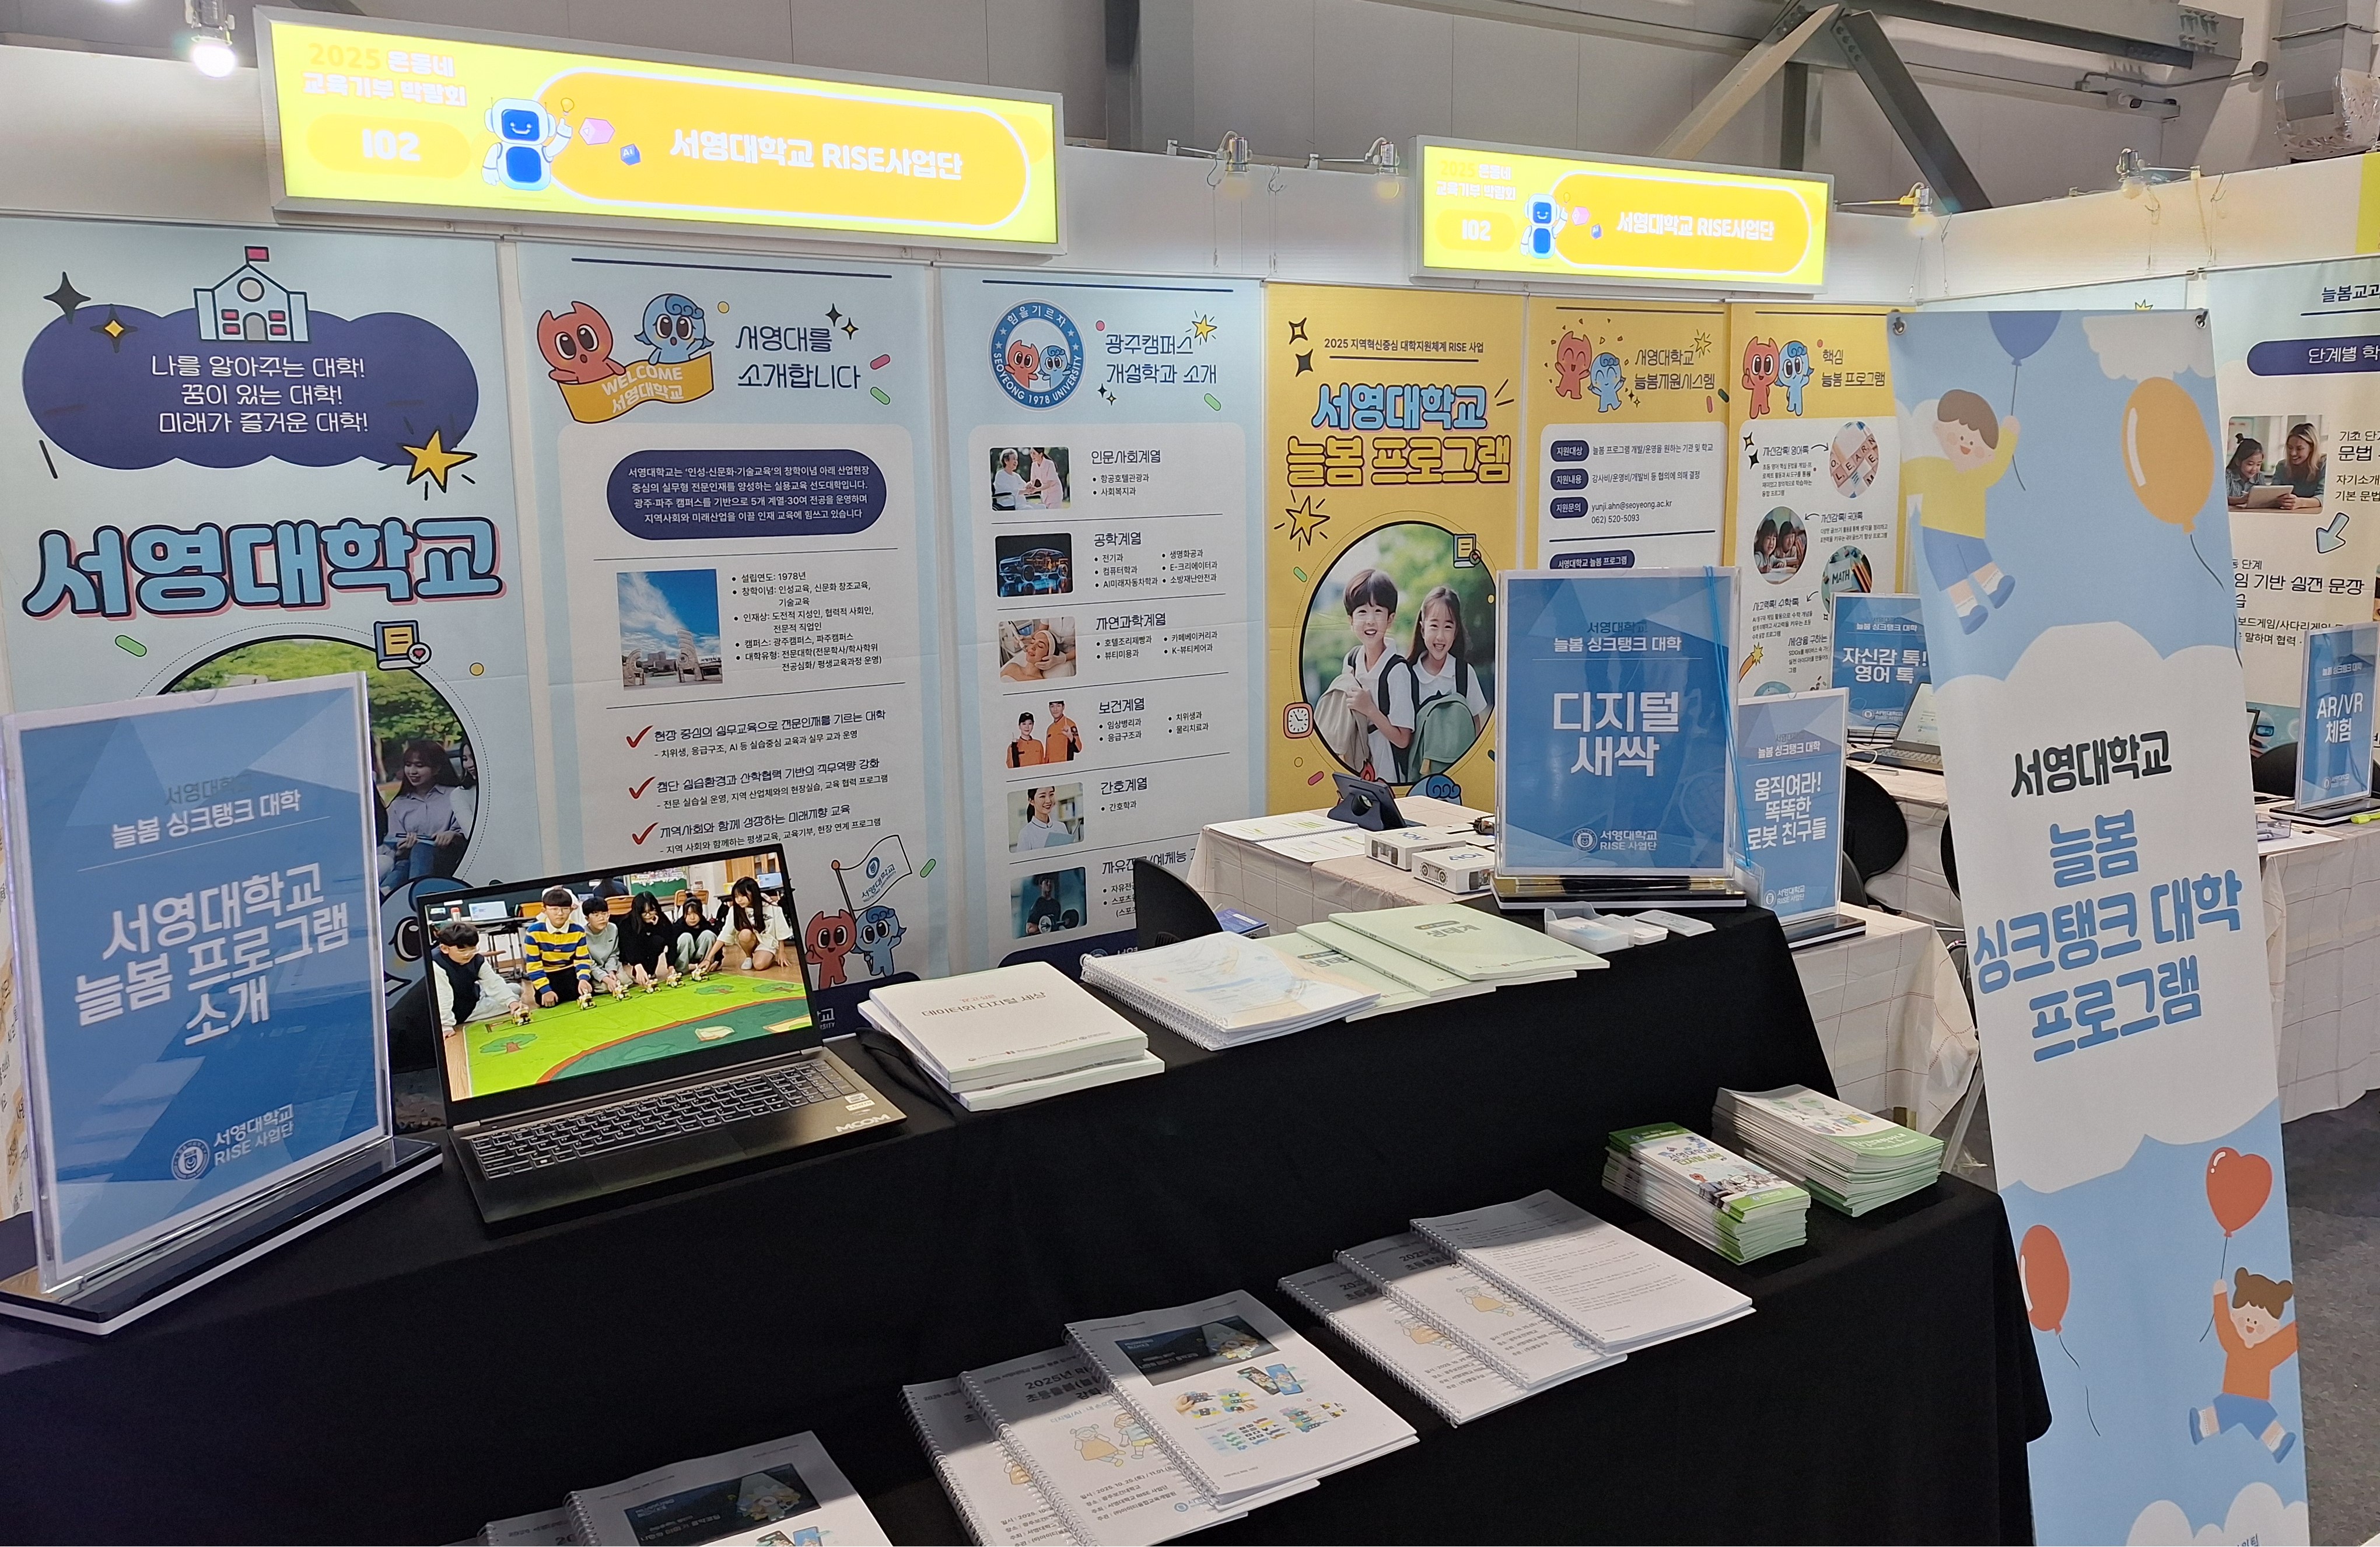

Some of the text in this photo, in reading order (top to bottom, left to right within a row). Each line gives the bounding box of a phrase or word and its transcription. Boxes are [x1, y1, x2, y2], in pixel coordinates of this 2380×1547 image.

[308, 43, 381, 70] 2025
[302, 72, 467, 107] 교육기부 박람회
[670, 129, 962, 180] 서영대학교 RISE사업단
[1616, 211, 1774, 241] 서영대학교 RISE사업단
[735, 325, 832, 352] 서영대를
[1105, 334, 1194, 355] 광주캠퍼스
[1324, 339, 1483, 352] 2025 지역혁신중심 대학지원체계 RISE 사업
[1634, 349, 1694, 366] 서영대학교
[1823, 349, 1843, 365] 핵심
[2308, 346, 2357, 364] 단계별
[152, 355, 365, 378] 나를 알아주는 대학!
[1107, 364, 1217, 384] 개설학과 소개
[601, 365, 682, 397] WELCOME
[737, 363, 861, 389] 소개합니다
[993, 352, 1082, 404] SEOYEONG 1978 UNIVERSITY
[1634, 373, 1714, 390] 늘봄지원시스템
[1822, 371, 1885, 387] 늘봄 프로그램
[181, 384, 342, 405] 꿈이 있는 대학!
[612, 384, 684, 414] 서영대학교
[1311, 383, 1488, 430] 서영대학교
[159, 412, 368, 433] 미래가 즐거운 대학!
[2339, 430, 2361, 442] 기초
[1091, 450, 1161, 464] 인문사회계열
[1556, 446, 1583, 456] 지원대상
[2338, 444, 2372, 462] 문법
[1286, 435, 1511, 487] 늘봄 프로그램
[632, 480, 868, 494] 중심의 실무형 전문인재를 양성하는 실용교육 선도대학입니다.
[1100, 474, 1149, 483] 항공호텔관광과
[1556, 474, 1582, 484] 지원내용
[1101, 487, 1136, 496] 사회복지과
[1556, 503, 1581, 513] 지원문의
[1591, 499, 1672, 512] yunji.ahn@seoyeong.ac.kr
[1591, 514, 1640, 524] 062) 520-5093
[1094, 532, 1142, 547] 공학계열
[1102, 554, 1124, 562] 전기과
[1170, 550, 1203, 559] 생명화공과
[1558, 556, 1627, 569] 서영대학교 늘봄 프로그램
[22, 516, 504, 619] 서영대학교
[1103, 566, 1138, 575] 컴퓨터학과
[1170, 562, 1217, 571] E-크리에이터과
[741, 572, 806, 582] 설립연도: 1978년
[1103, 577, 1158, 588] AI미래자동차학과
[1170, 573, 1216, 583] 소방재난안전과
[1832, 568, 1850, 584] MATH
[2254, 574, 2364, 595] 기반 실전 문장
[779, 597, 810, 607] 기술교육
[1096, 612, 1166, 631] 자연과학계열
[1587, 622, 1647, 634] 서영대학교
[745, 632, 854, 648] 캠퍼스: 광주캠퍼스, 파주캠퍼스
[1104, 636, 1152, 647] 호텔조리제빵과
[1171, 631, 1217, 642] 카페베이커리과
[1553, 636, 1682, 652] 늘봄 싱크탱크 대학
[1104, 649, 1139, 659] 뷰티미용과
[1172, 644, 1213, 654] K-뷰티케어과
[1842, 648, 1896, 665] 자신감
[1902, 649, 1927, 667] 톡!
[1855, 666, 1915, 684] 영어 톡
[1098, 698, 1145, 715] 보건계열
[1553, 692, 1679, 733] 디지털
[2316, 692, 2364, 719] AR/VR
[1107, 718, 1141, 729] 임상병리과
[1175, 712, 1202, 720] 치위생과
[654, 709, 886, 742] 현장 중심의 실무교육으로 전문인재를 기르는 대학
[1176, 723, 1208, 734] 물리치료과
[2325, 718, 2351, 743] 체험
[1107, 731, 1142, 742] 응급구조과
[1570, 736, 1660, 777] 새싹
[1758, 741, 1821, 759] 늘봄 싱크탱크 대학
[2011, 730, 2172, 798] 서영대학교
[1101, 777, 1147, 795] 간호계열
[1755, 771, 1821, 801] 움직여라!
[1109, 801, 1137, 811] 간호학과
[1765, 796, 1811, 822] 똑똑한
[111, 789, 301, 849] 늘봄 싱크탱크 대학
[1600, 830, 1657, 841] 서영대학교
[1746, 817, 1826, 851] 로봇 친구들
[1600, 841, 1657, 850] RISE 사업단
[2050, 809, 2139, 888] 늘봄
[861, 864, 895, 898] 서영대학교
[102, 862, 324, 960] 서영대학교
[1973, 869, 2243, 995] 싱크탱크 대학
[75, 902, 349, 1027] 늘봄 프로그램
[979, 998, 1020, 1009] 디지털
[1020, 992, 1046, 1002] 세상
[2029, 955, 2202, 1062] 프로그램
[184, 975, 269, 1045] 소개
[214, 1104, 294, 1146] 서영대학교
[214, 1121, 294, 1167] RISE 사업단
